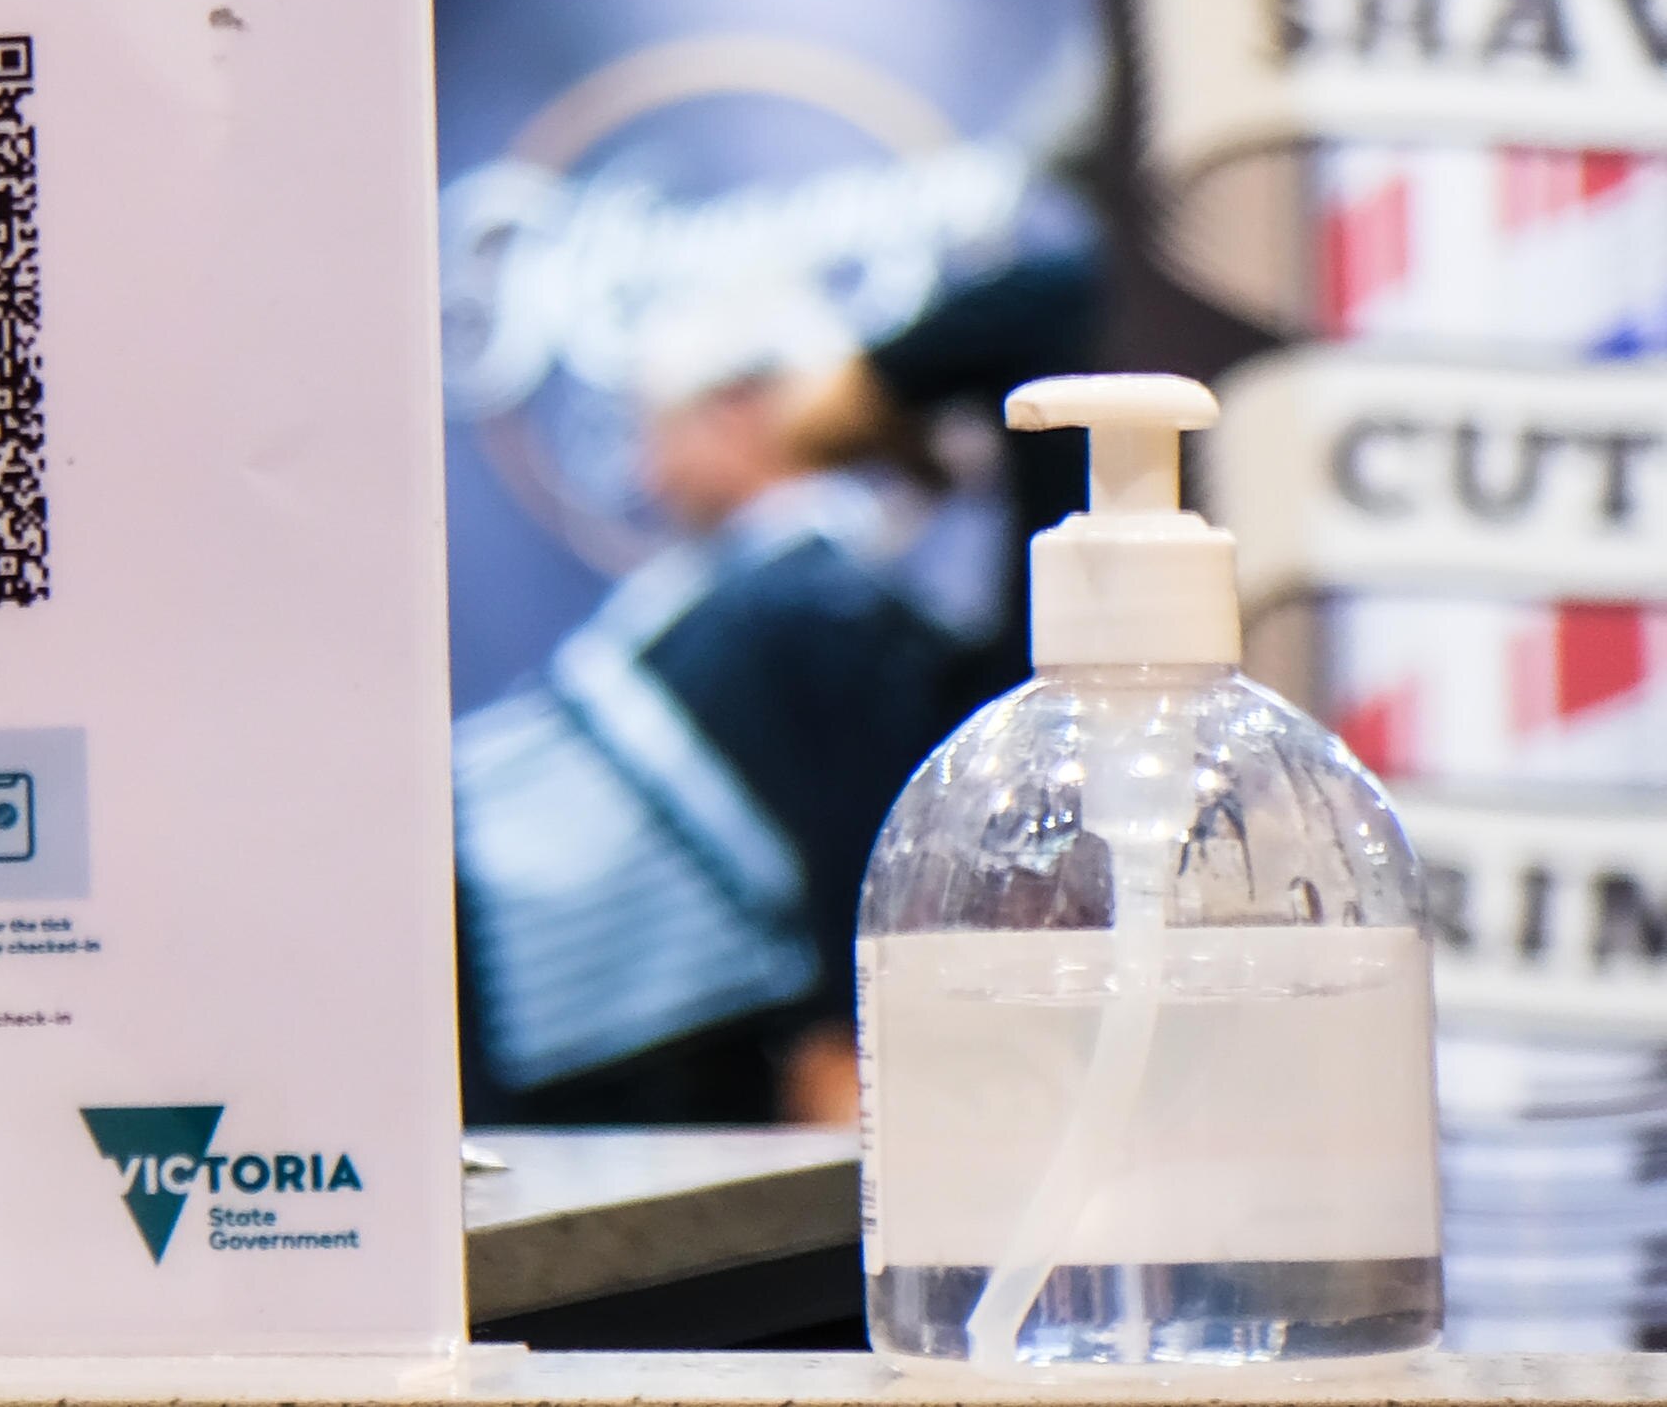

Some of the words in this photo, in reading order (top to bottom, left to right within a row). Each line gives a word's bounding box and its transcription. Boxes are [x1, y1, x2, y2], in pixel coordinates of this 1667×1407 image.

[1327, 412, 1664, 524] CUT
[10, 917, 37, 933] the
[41, 916, 72, 932] tick
[101, 1151, 365, 1195] VICTORIA
[207, 1206, 277, 1228] State
[207, 1229, 360, 1251] Government
